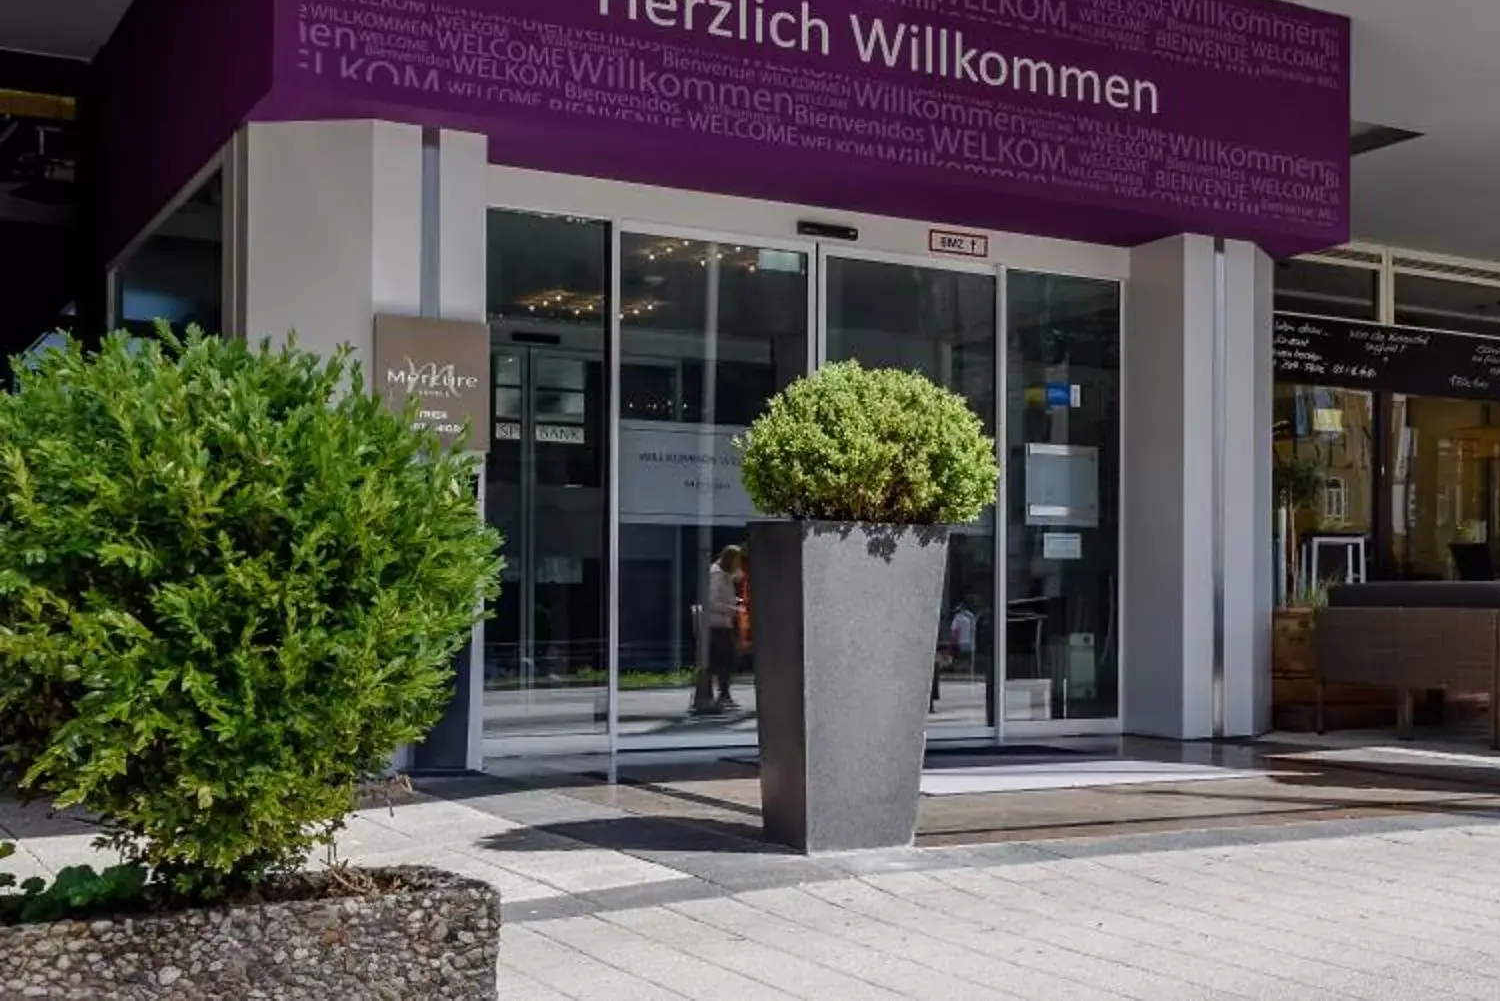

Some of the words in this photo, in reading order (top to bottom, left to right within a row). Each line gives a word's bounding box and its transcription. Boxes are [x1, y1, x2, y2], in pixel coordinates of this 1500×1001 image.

[310, 4, 434, 38] WILLKOMMEN
[436, 29, 566, 70] WELCOME
[848, 12, 1161, 116] Willkommen
[1155, 29, 1250, 64] BIENVENUE
[452, 53, 561, 90] WELKOM
[566, 49, 795, 116] Willkommen
[564, 79, 682, 115] Bienvenidos
[854, 79, 1026, 132] Willkommen
[688, 109, 800, 149] WELCOME
[795, 104, 925, 144] Bienvenidos
[930, 124, 1067, 175] WELKOM
[1167, 131, 1325, 180] Willkommen
[1155, 169, 1250, 201] BIENVENUE
[1250, 177, 1328, 205] WELCOME
